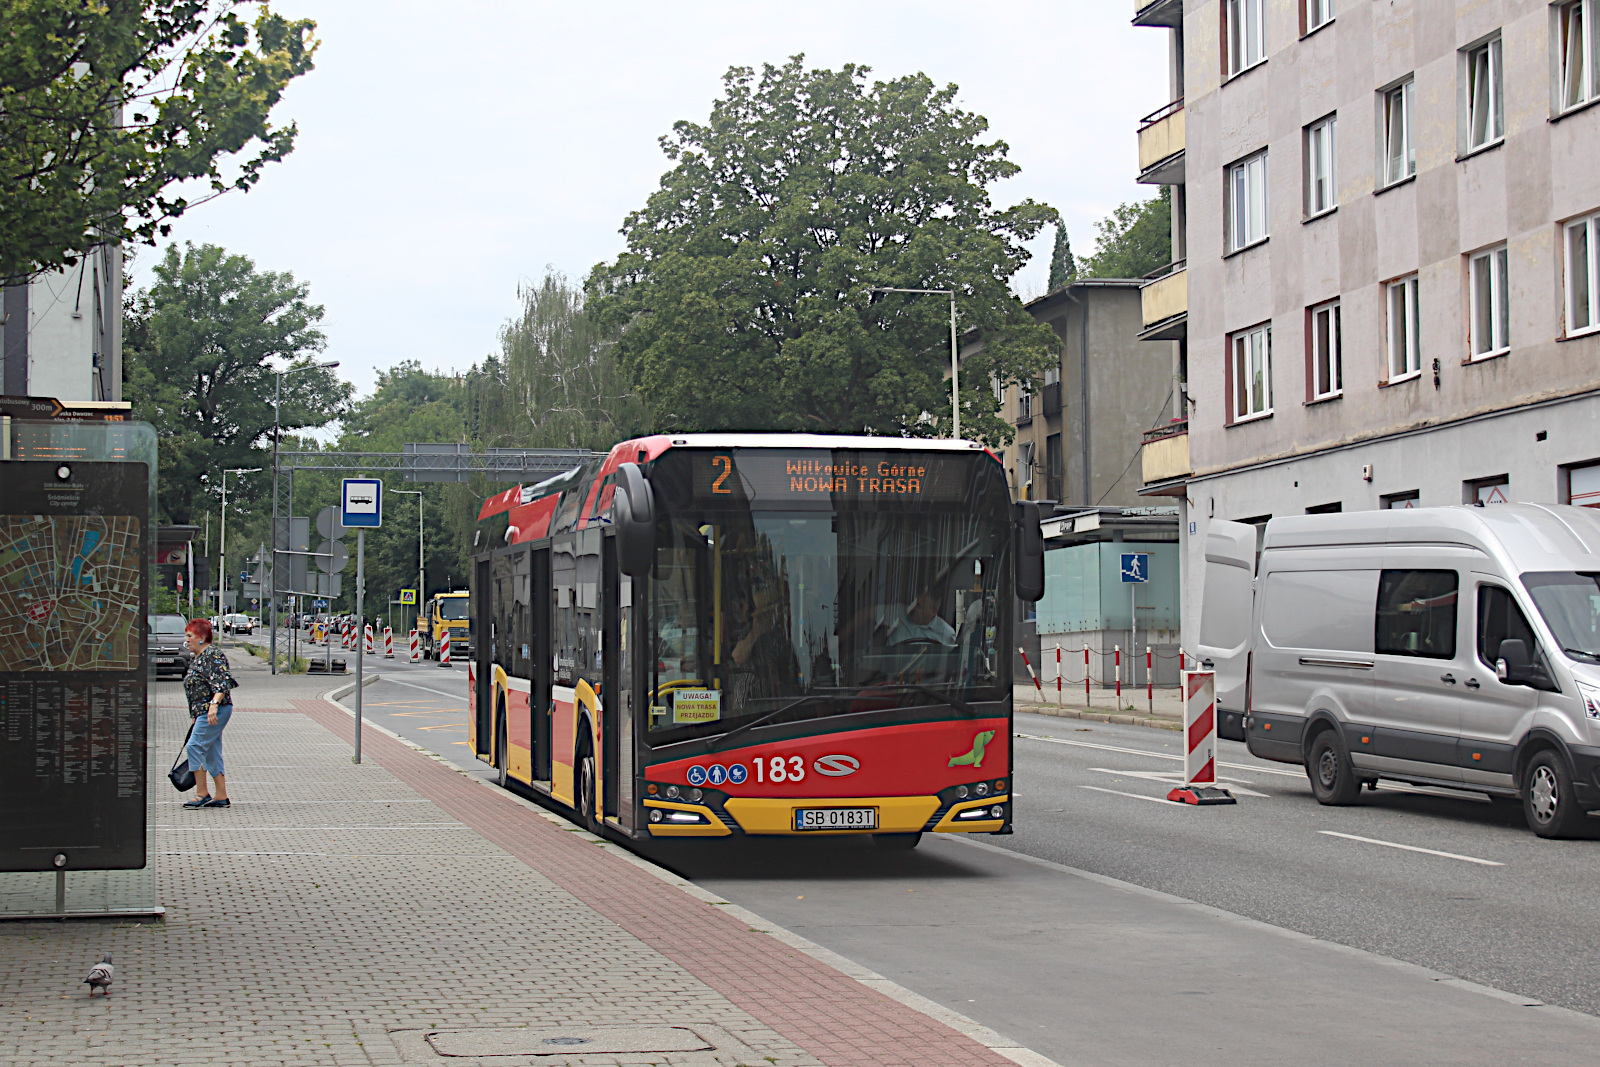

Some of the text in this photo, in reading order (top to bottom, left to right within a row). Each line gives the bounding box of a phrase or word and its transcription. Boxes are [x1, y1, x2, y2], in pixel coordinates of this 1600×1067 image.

[0, 398, 30, 406] tobusowy
[31, 403, 53, 411] 300m
[712, 455, 732, 494] 2
[786, 460, 926, 477] Wilkowice Górne
[790, 476, 921, 493] NOWA TRASA
[753, 756, 805, 782] 183
[805, 810, 872, 825] SB 0183T
